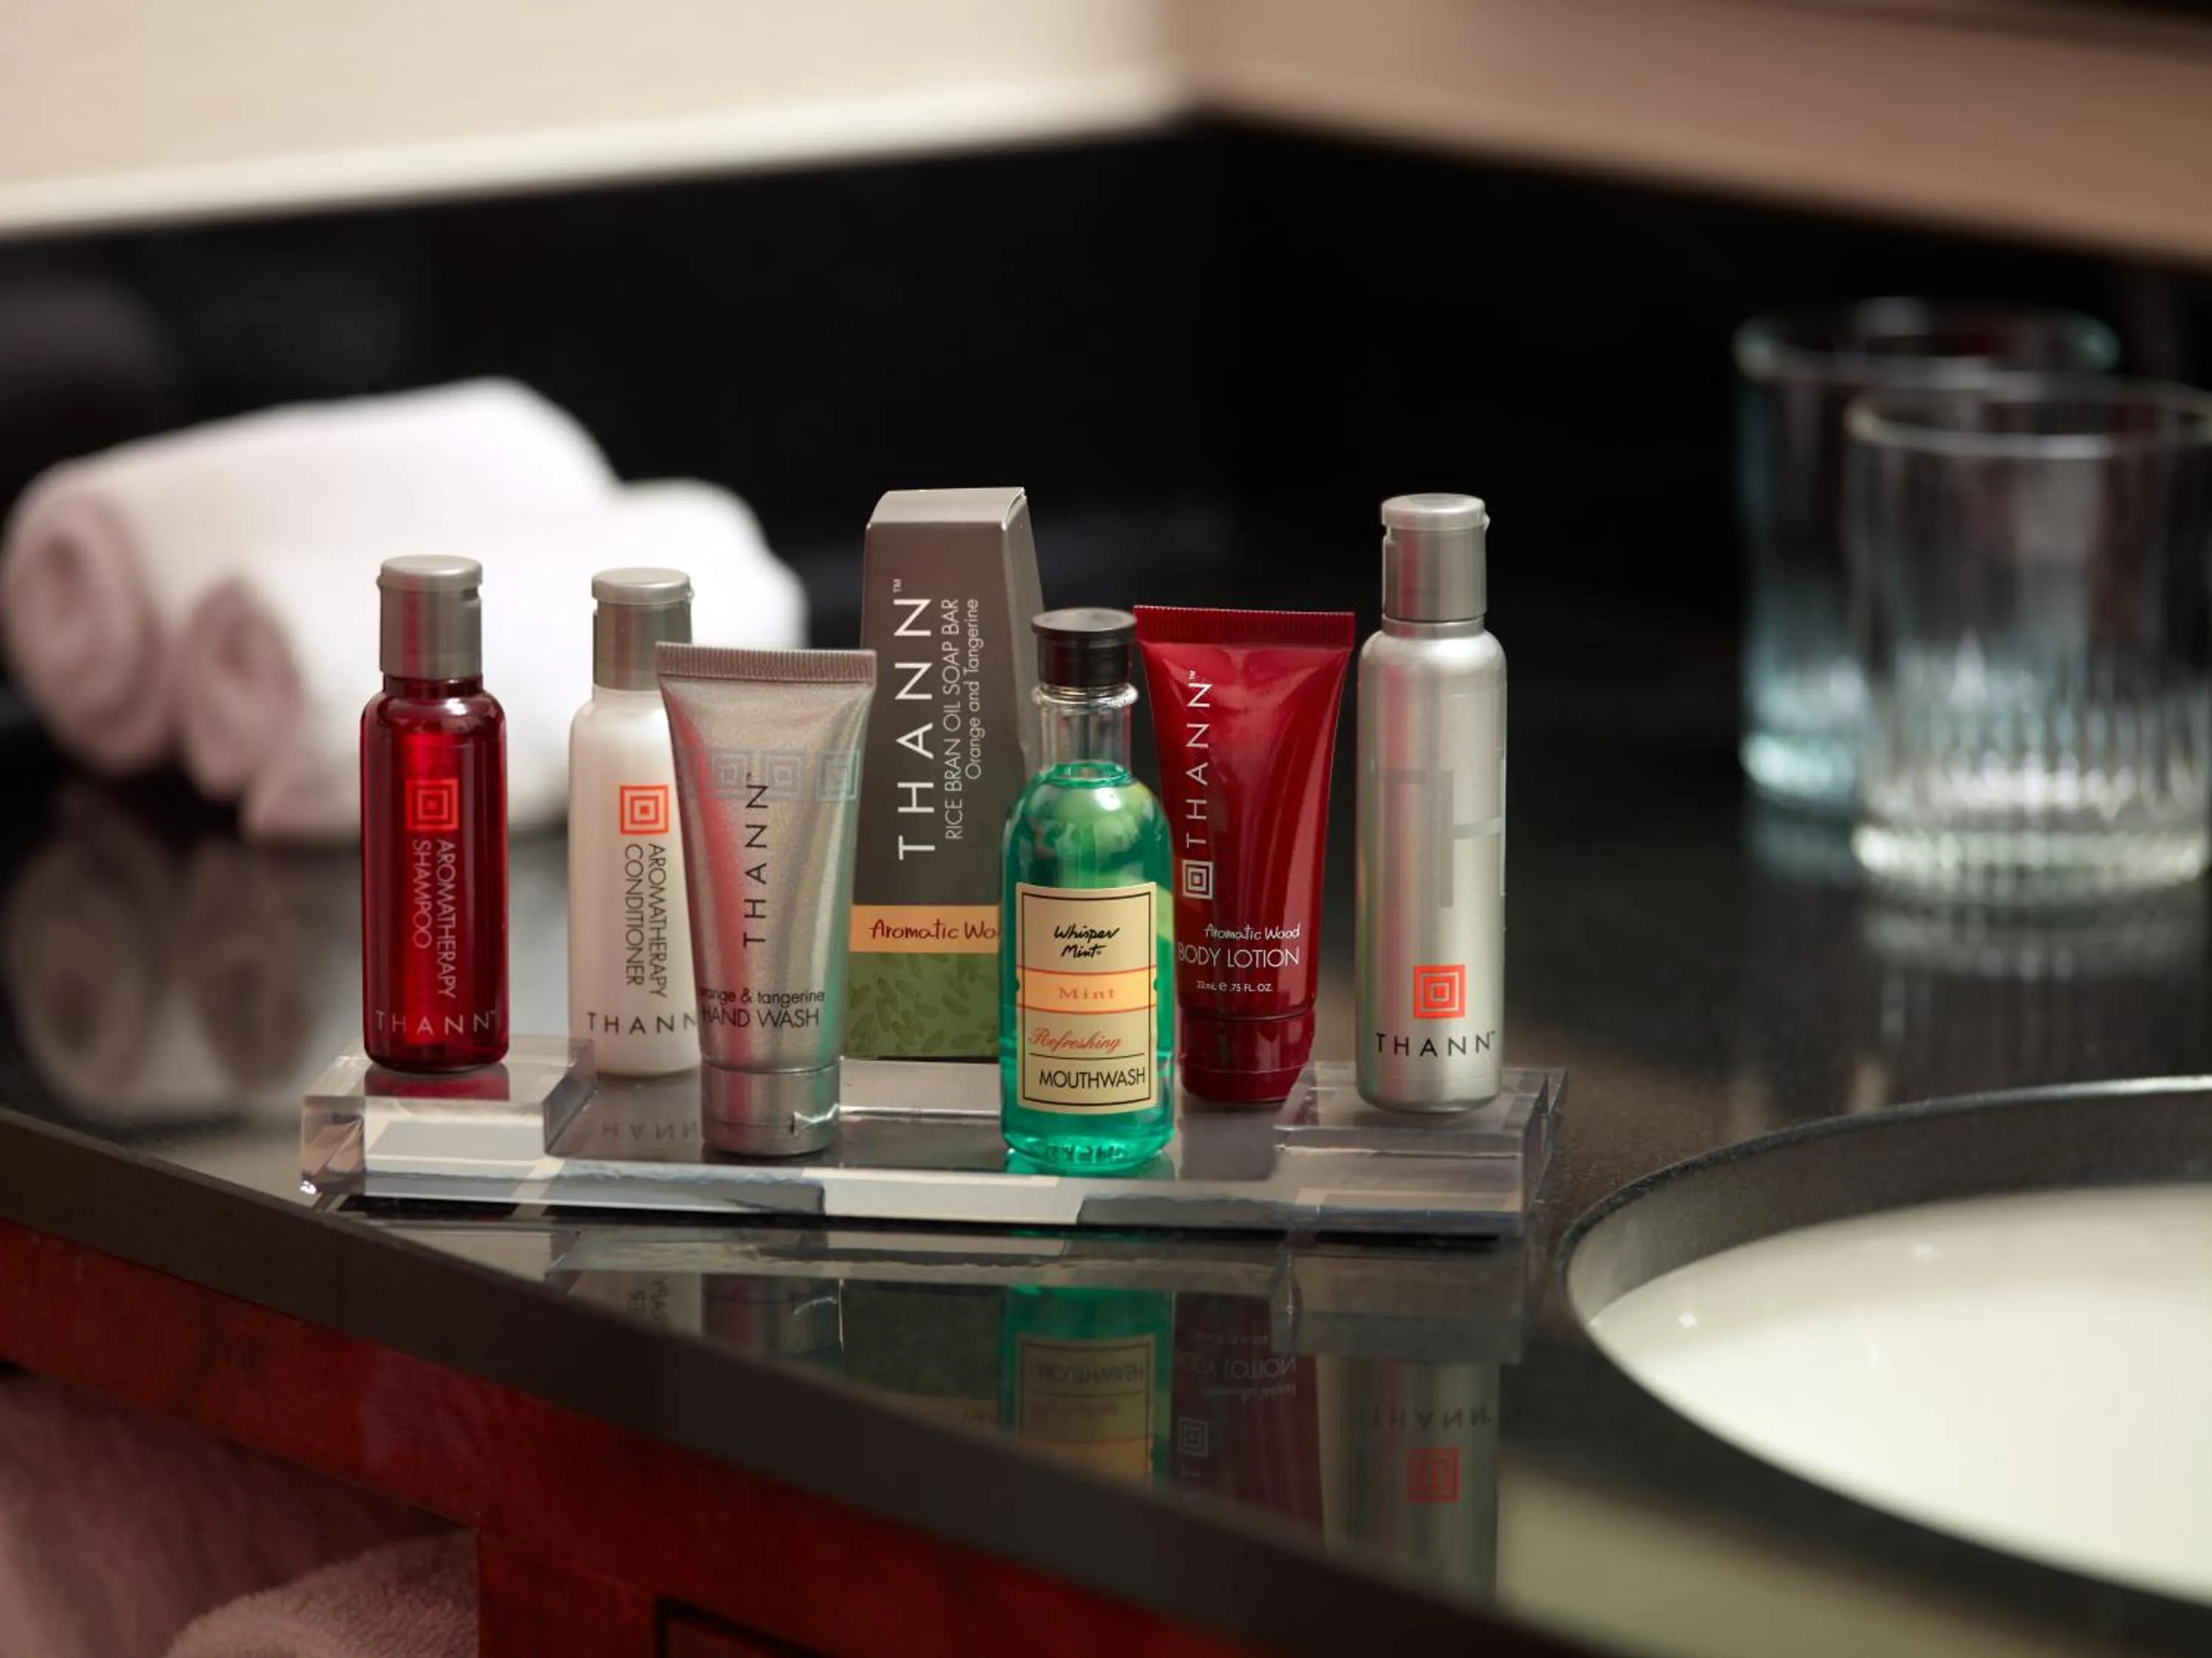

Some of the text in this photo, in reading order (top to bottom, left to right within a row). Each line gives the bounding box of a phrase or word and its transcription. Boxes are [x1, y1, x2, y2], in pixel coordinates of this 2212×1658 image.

[964, 598, 985, 780] Orange and Tangerine
[893, 597, 936, 860] THANN
[942, 599, 963, 840] RICE BRAN OIL SOAP BAR
[1186, 682, 1213, 849] THANN
[743, 784, 769, 948] THANN
[413, 839, 432, 948] SHAMPOO
[437, 839, 456, 999] AROMATHERAPY
[625, 844, 644, 986] CONDITIONER
[648, 843, 668, 998] AROMATHERAPY
[869, 918, 1000, 940] Aromatic Wo
[1054, 923, 1120, 943] Whisper
[1203, 923, 1301, 940] Aromatic Wood
[1178, 942, 1301, 968] BODY LOTION
[757, 989, 826, 1009] tangerine
[1060, 987, 1116, 999] Mint
[375, 1010, 490, 1035] THANN
[701, 1005, 819, 1027] HAND WASH
[1028, 1027, 1121, 1052] Refreshing
[1375, 1033, 1490, 1058] THANN
[1039, 1068, 1146, 1089] MOUTHWASH
